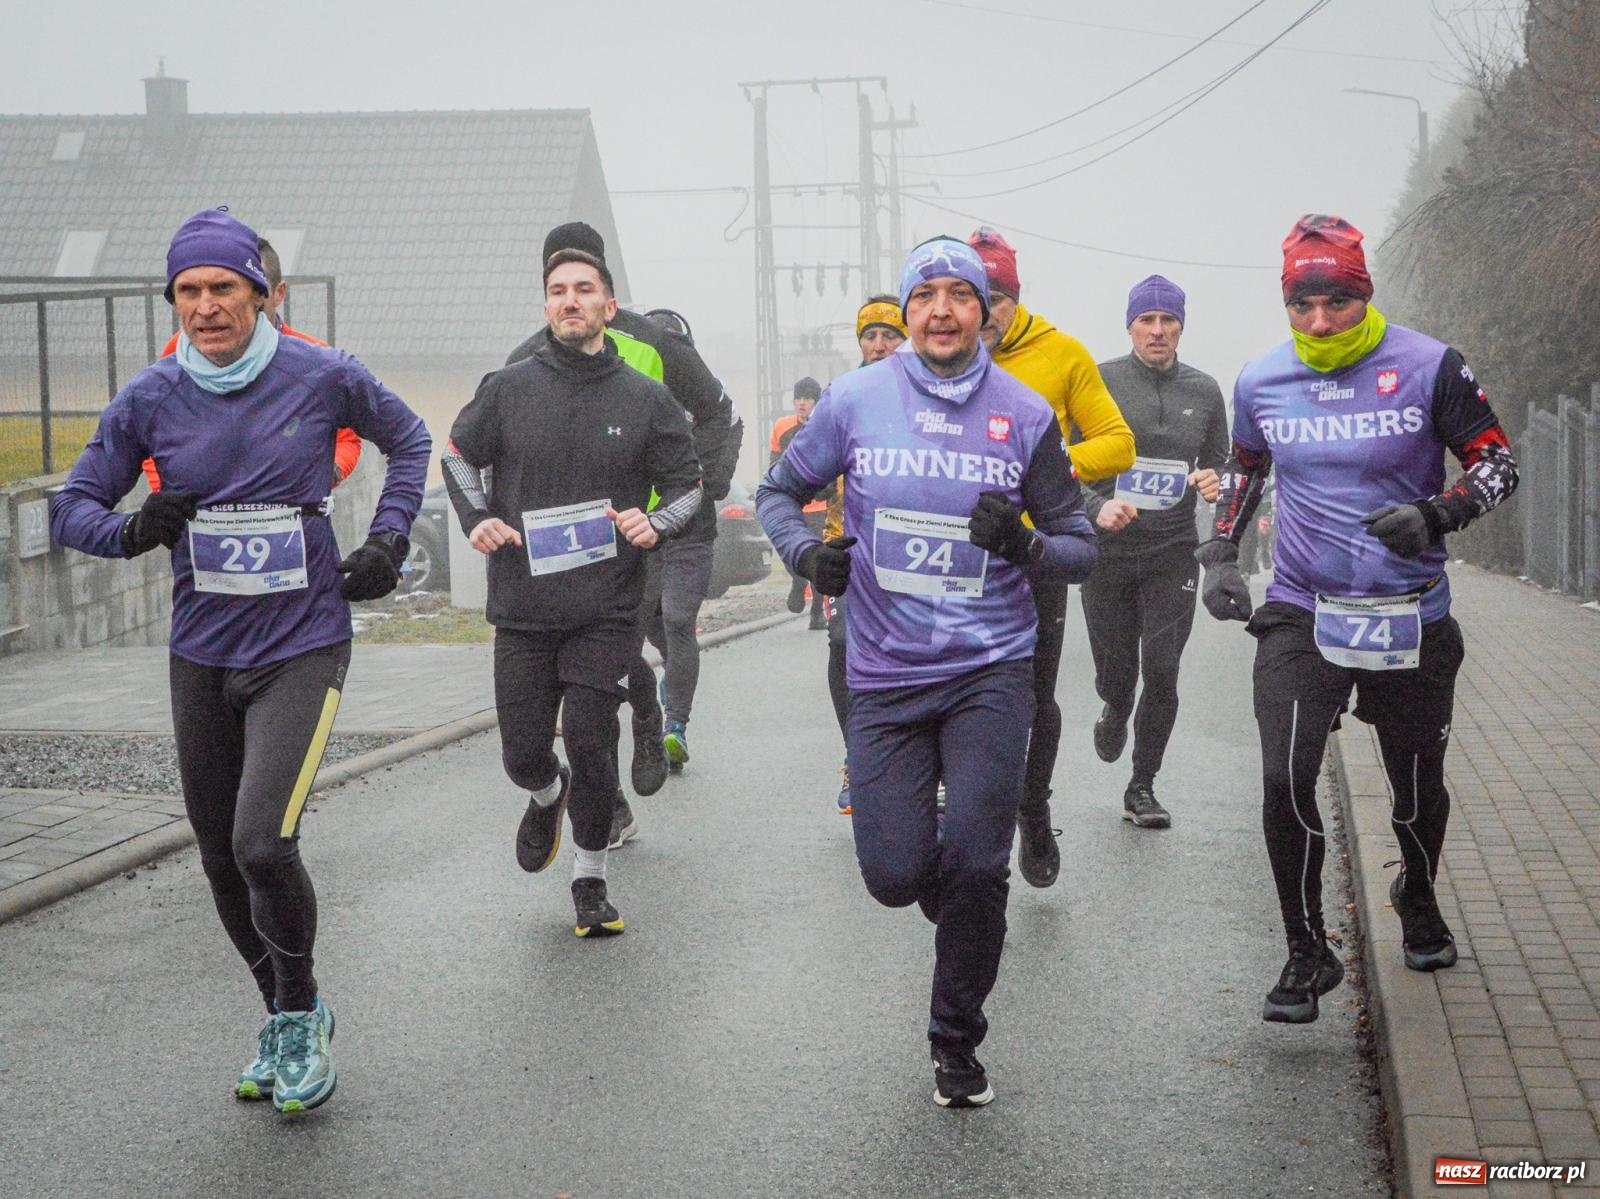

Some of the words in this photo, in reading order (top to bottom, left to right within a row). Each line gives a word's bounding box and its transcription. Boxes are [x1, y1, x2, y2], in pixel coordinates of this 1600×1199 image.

[1260, 405, 1424, 445] RUNNERS
[854, 446, 1024, 489] RUNNERS
[1130, 471, 1175, 496] 142
[219, 536, 271, 572] 29
[563, 525, 582, 552] 1
[905, 537, 954, 574] 94
[1346, 616, 1393, 650] 74
